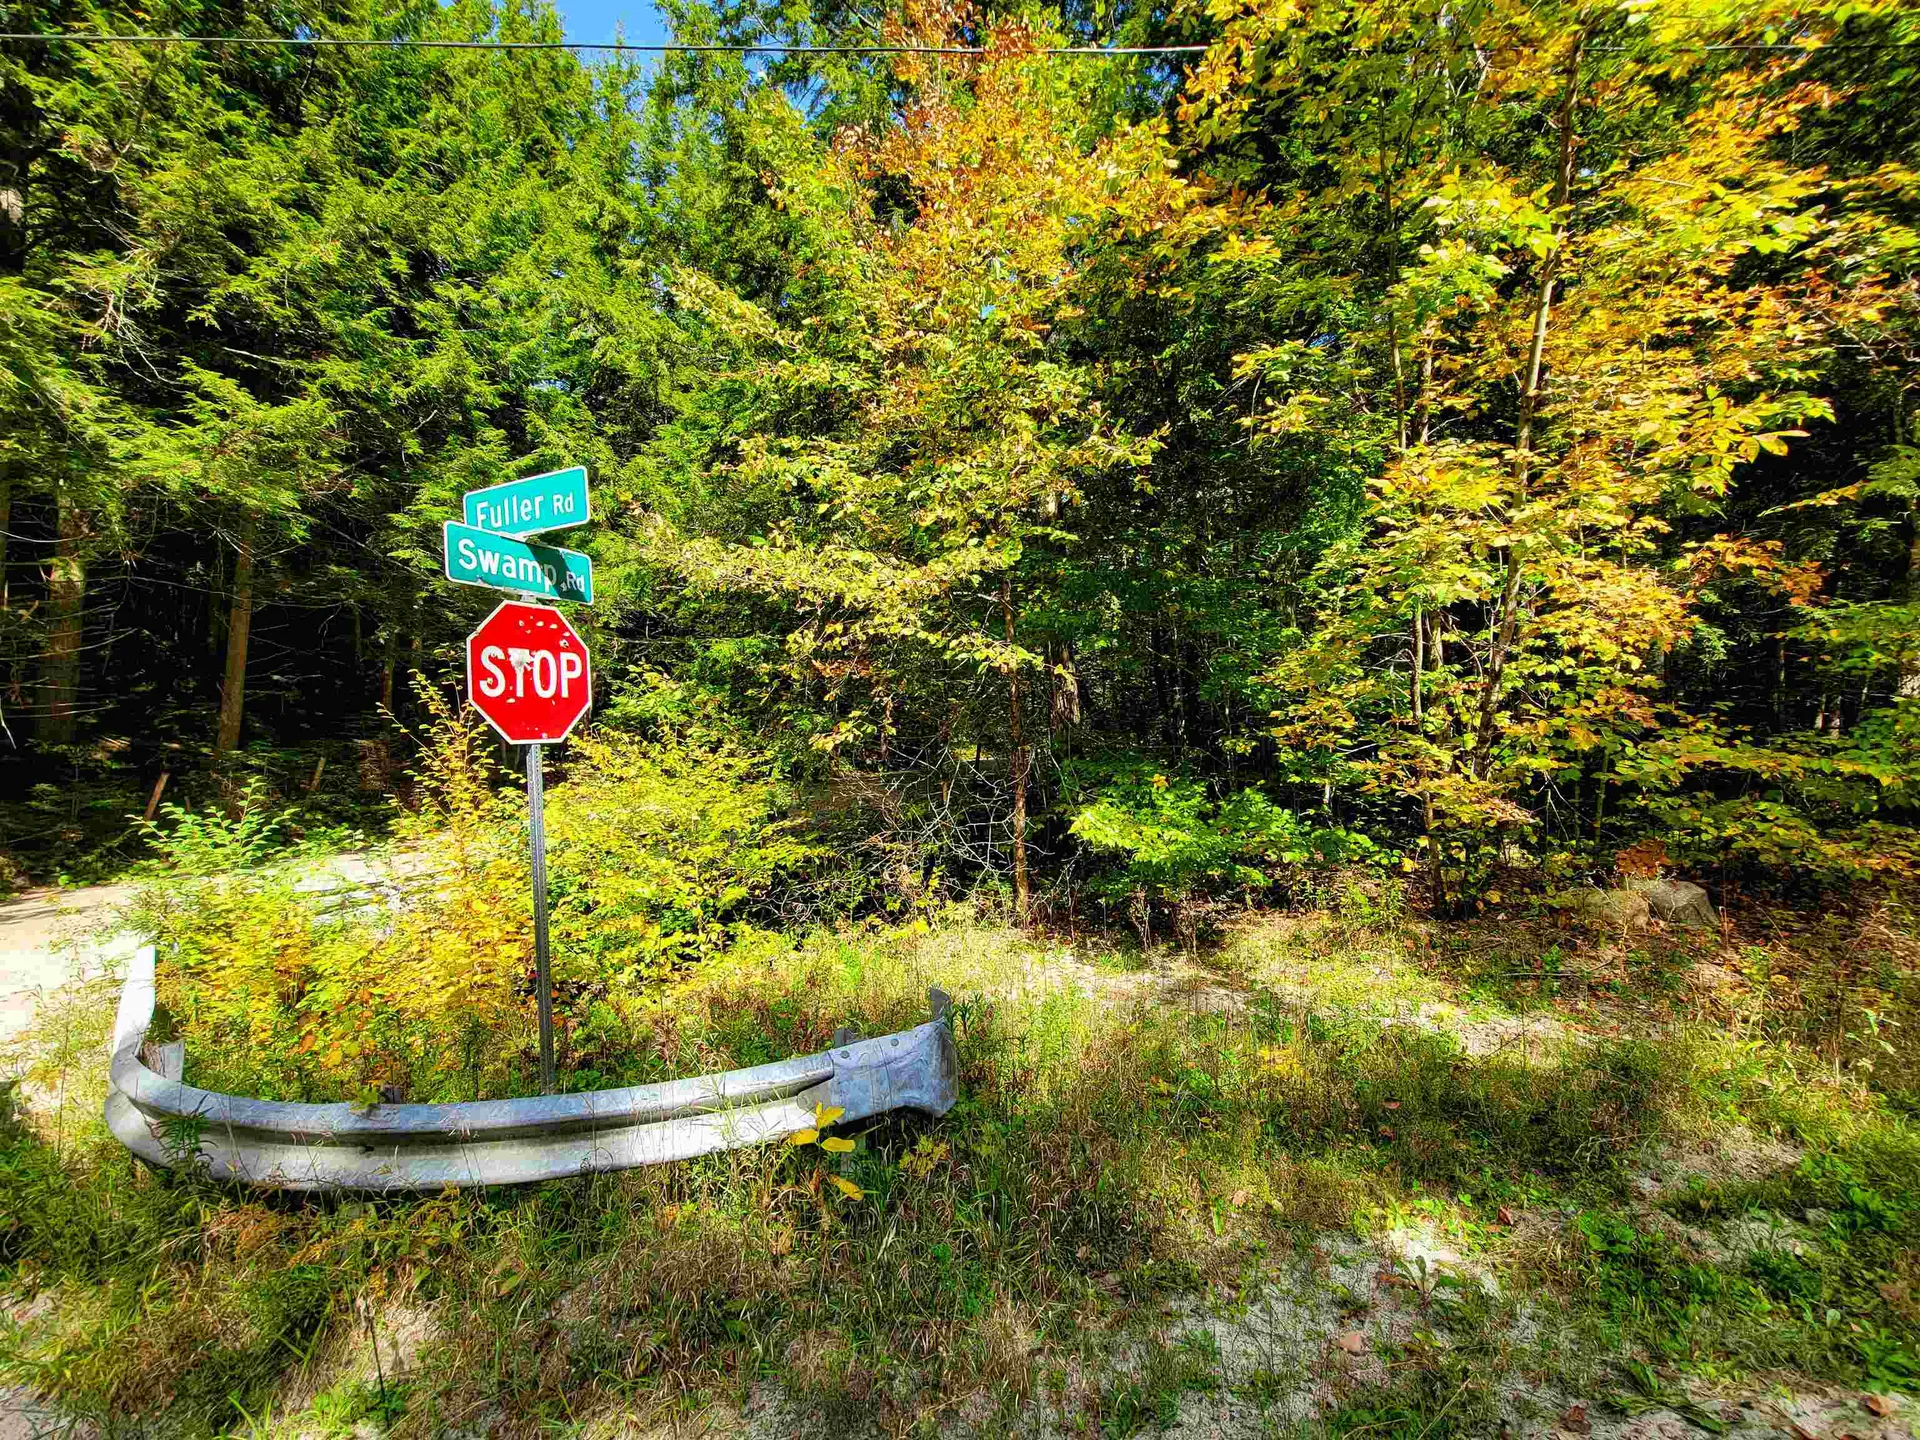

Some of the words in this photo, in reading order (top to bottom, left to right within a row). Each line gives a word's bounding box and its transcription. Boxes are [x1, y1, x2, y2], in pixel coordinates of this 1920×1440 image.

[476, 495, 544, 529] Fuller
[552, 492, 574, 516] Rd
[458, 538, 557, 593] Swamp
[566, 570, 585, 593] Rd
[480, 645, 582, 698] STOP
